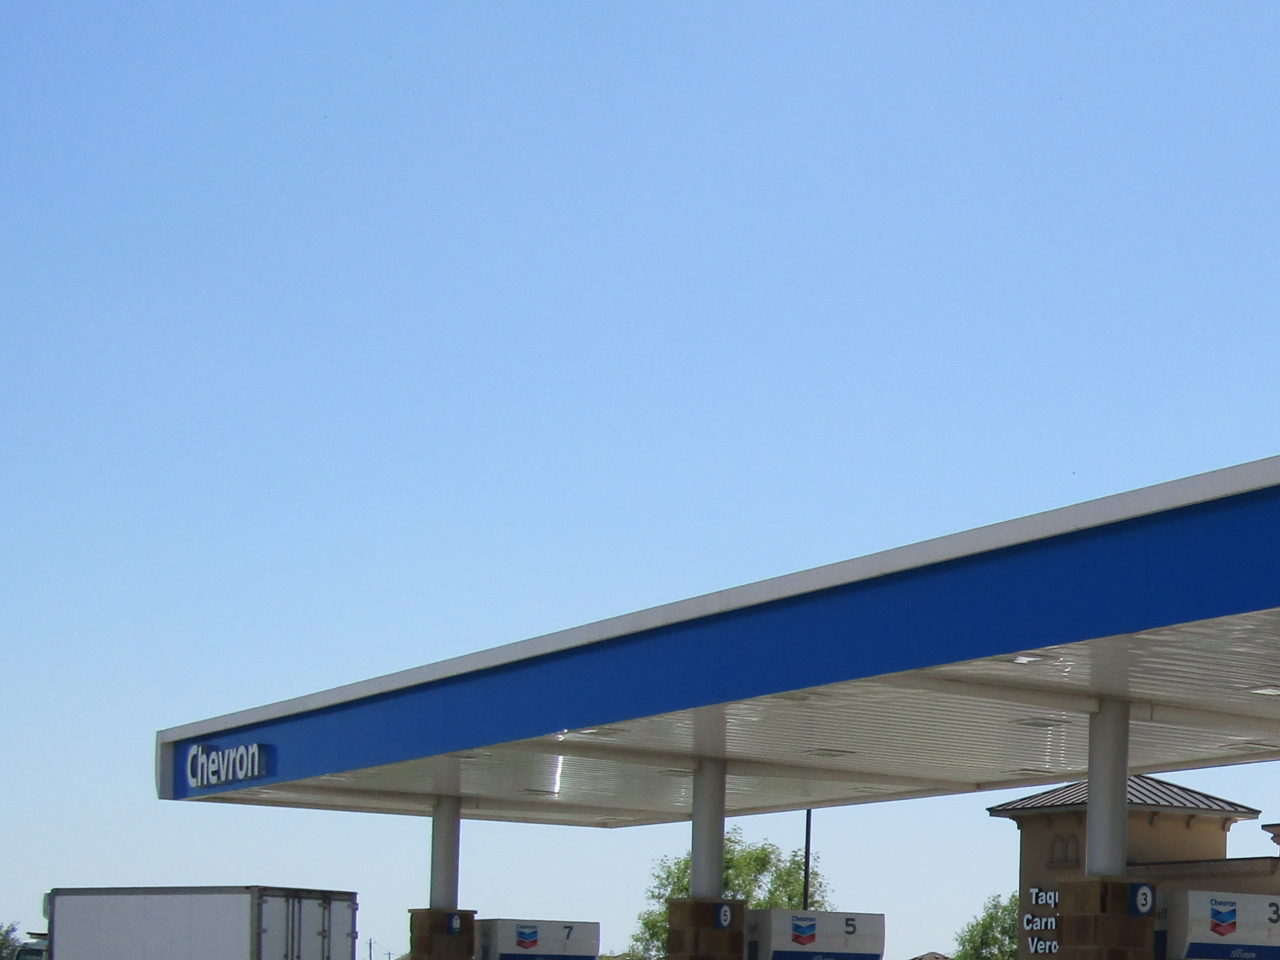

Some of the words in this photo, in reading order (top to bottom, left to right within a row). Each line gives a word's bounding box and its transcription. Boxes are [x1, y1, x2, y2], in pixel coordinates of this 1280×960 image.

[186, 743, 259, 788] Chevron
[1140, 892, 1148, 908] 3
[1210, 898, 1237, 907] Chevron
[722, 909, 729, 922] 5
[1267, 902, 1280, 924] 3
[844, 917, 857, 935] 5
[1023, 913, 1059, 930] Carn
[563, 925, 573, 940] 7
